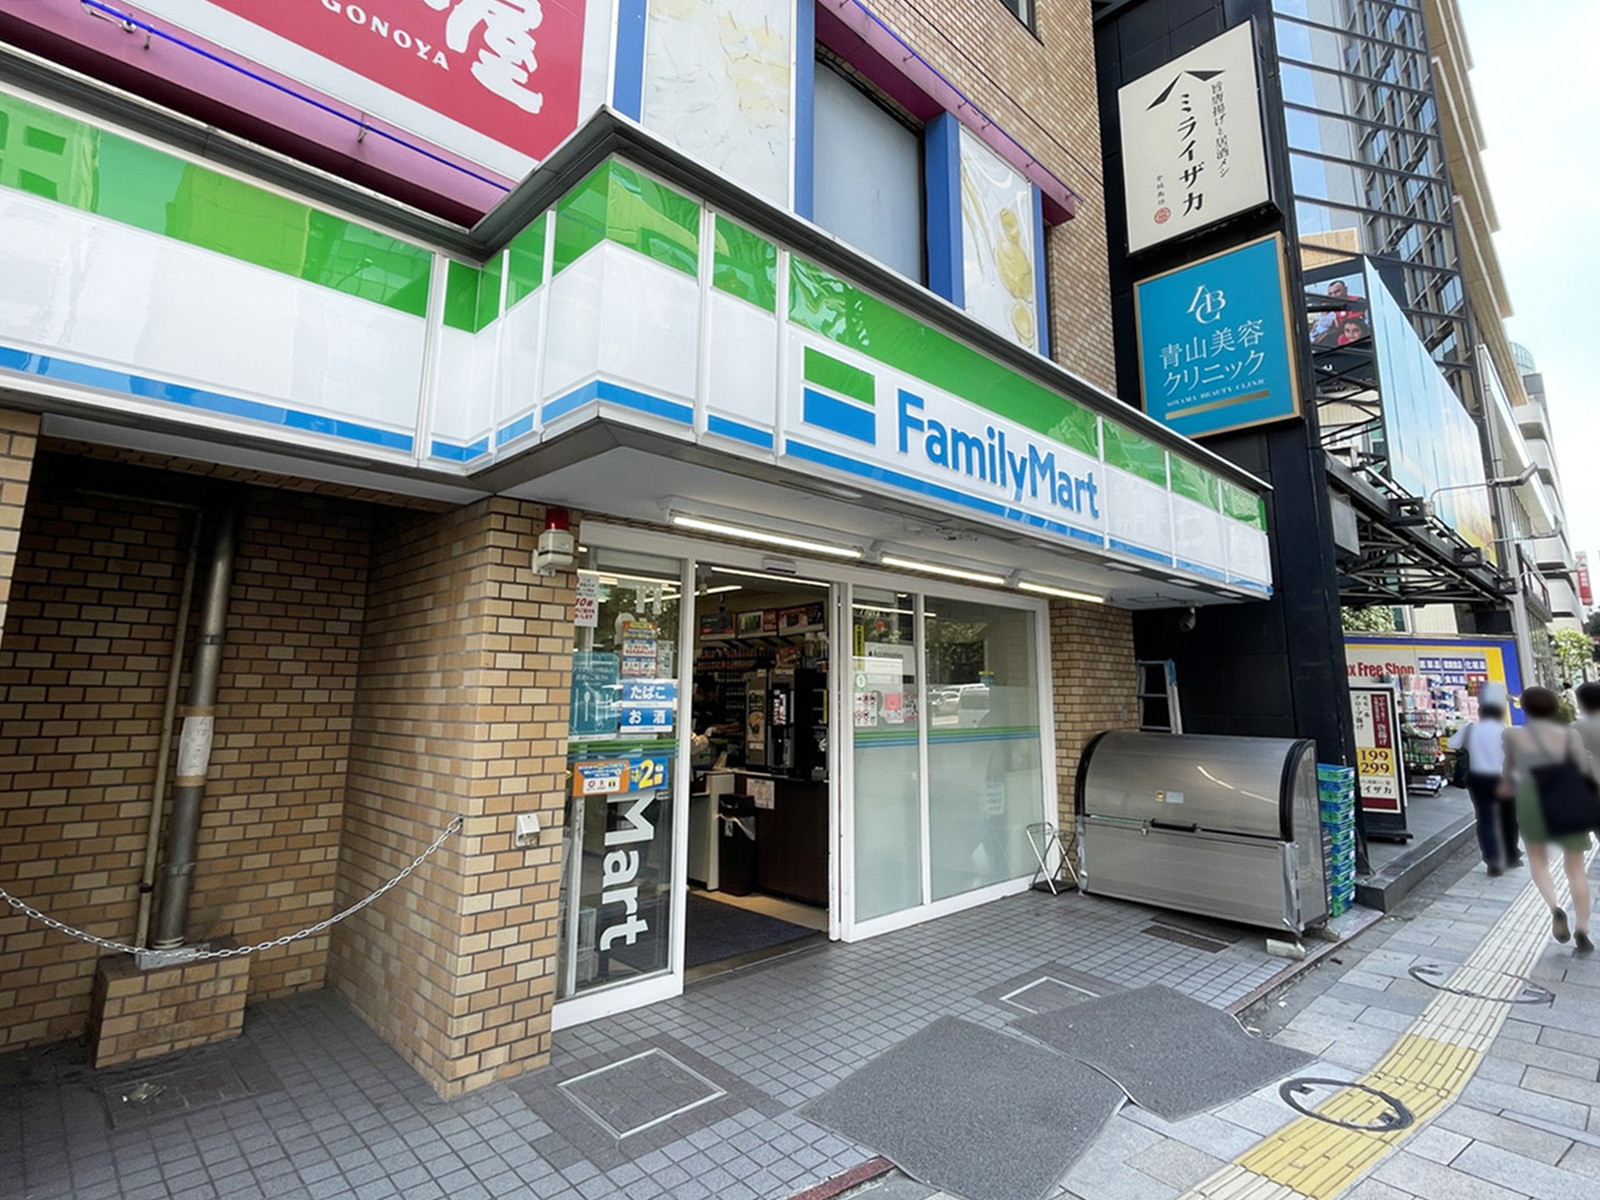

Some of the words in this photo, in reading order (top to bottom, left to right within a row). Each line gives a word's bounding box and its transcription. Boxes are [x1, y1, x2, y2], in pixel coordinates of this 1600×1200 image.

[1177, 93, 1205, 217] ミライザカ
[1159, 319, 1264, 370] 青山美容
[1163, 350, 1265, 397] クリニック
[1201, 386, 1232, 399] BEAUTY
[1235, 378, 1265, 390] CLINIC
[897, 388, 1099, 519] FamilyMart
[1357, 662, 1383, 677] Free
[630, 685, 666, 699] たばこ
[629, 710, 666, 724] お酒
[1361, 750, 1389, 761] 199
[1360, 762, 1390, 774] 299
[600, 787, 655, 951] Mart
